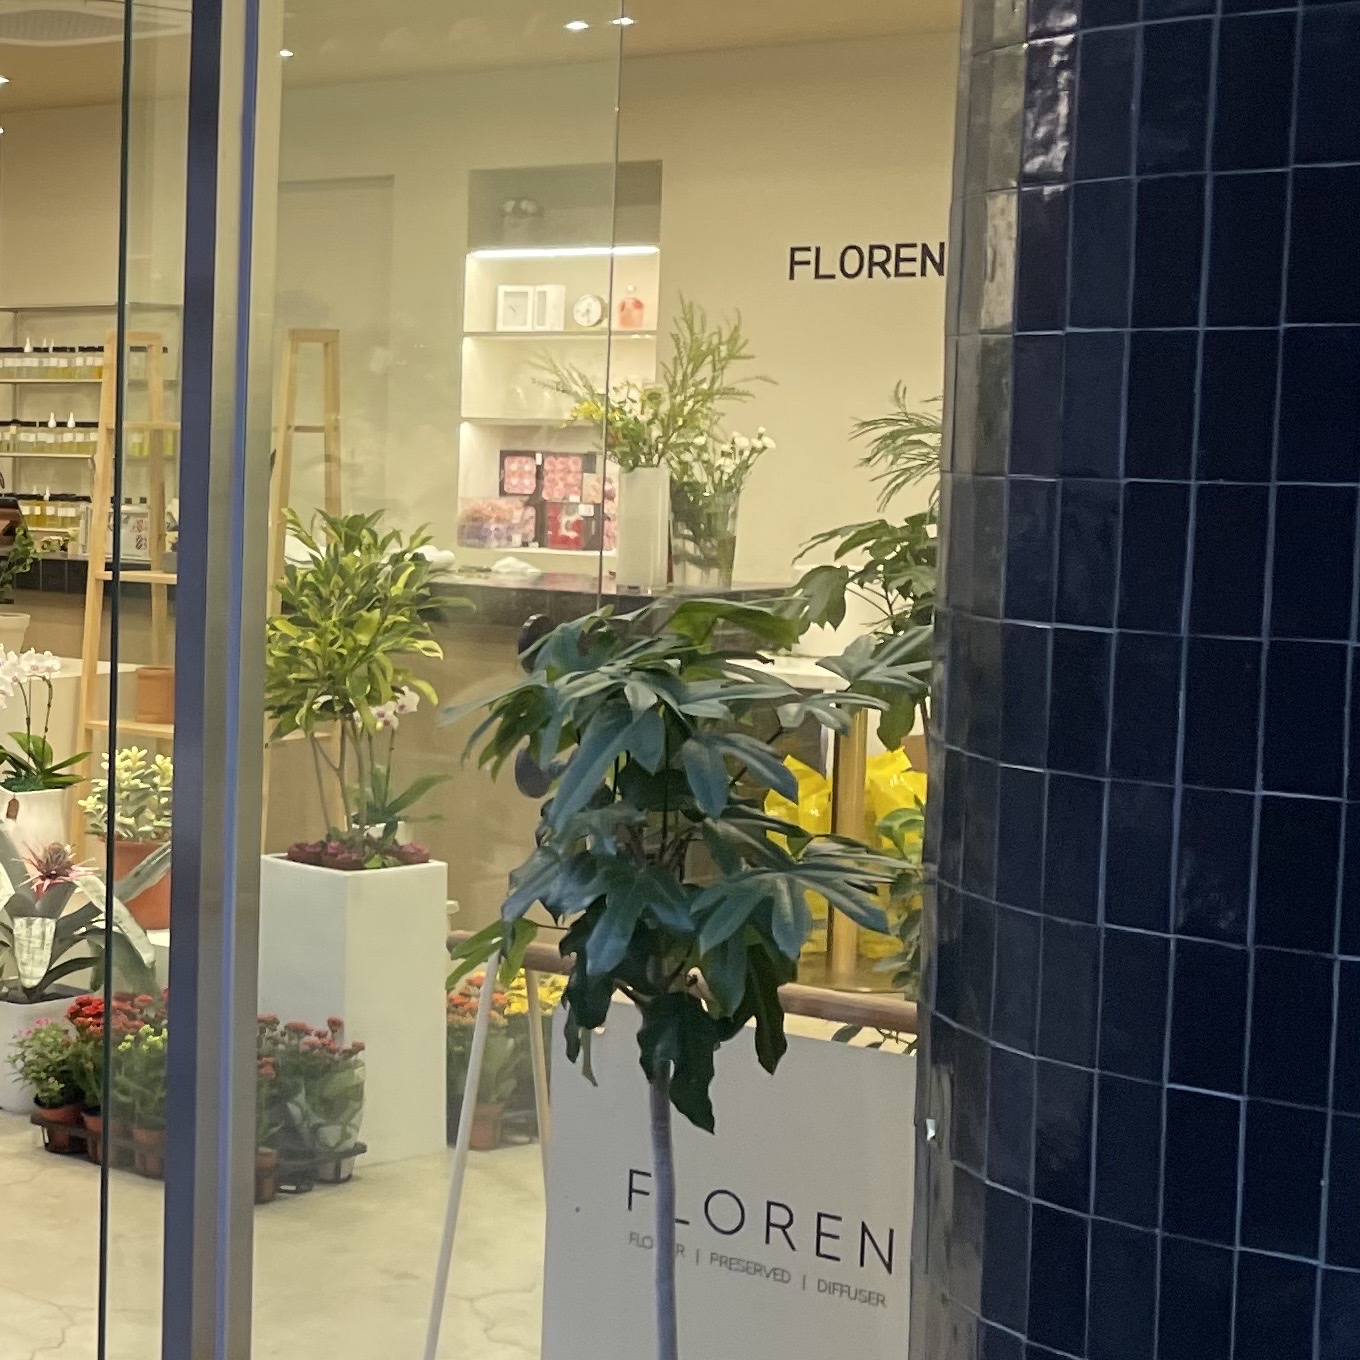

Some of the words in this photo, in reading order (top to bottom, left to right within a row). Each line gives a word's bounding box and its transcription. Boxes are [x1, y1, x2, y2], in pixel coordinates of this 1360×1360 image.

[788, 241, 946, 281] FLOREN
[626, 1167, 896, 1276] FOREN
[628, 1230, 687, 1259] FLOR
[709, 1251, 792, 1286] PRESERVED
[816, 1277, 889, 1309] DIFFUSER
